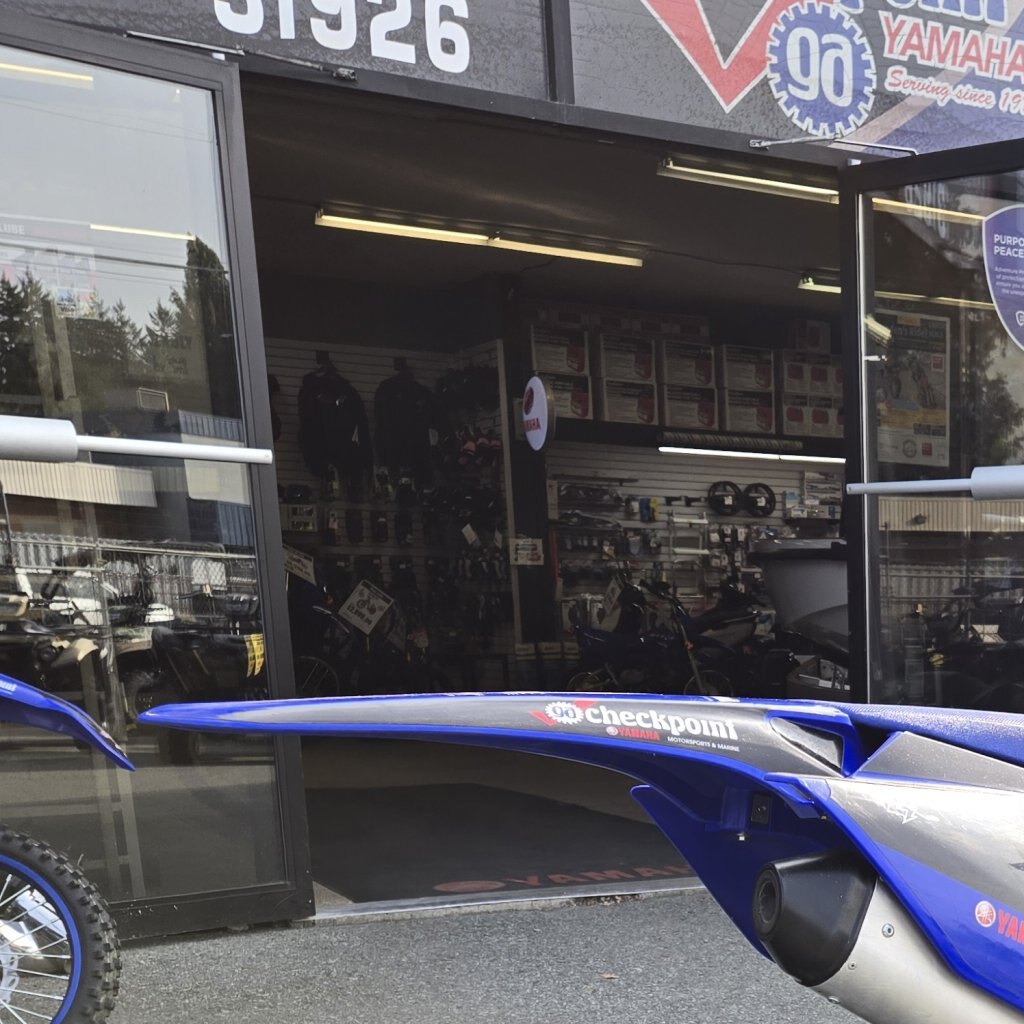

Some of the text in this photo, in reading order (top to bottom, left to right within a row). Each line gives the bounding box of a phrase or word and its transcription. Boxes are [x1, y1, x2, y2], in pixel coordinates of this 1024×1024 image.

[887, 68, 951, 100] Serving
[955, 88, 993, 105] since
[994, 246, 1024, 258] PEACE
[585, 705, 738, 740] checkpoint
[619, 728, 660, 741] YAMAHA
[667, 736, 710, 748] MOTORSPORTS
[717, 743, 740, 752] MARINE
